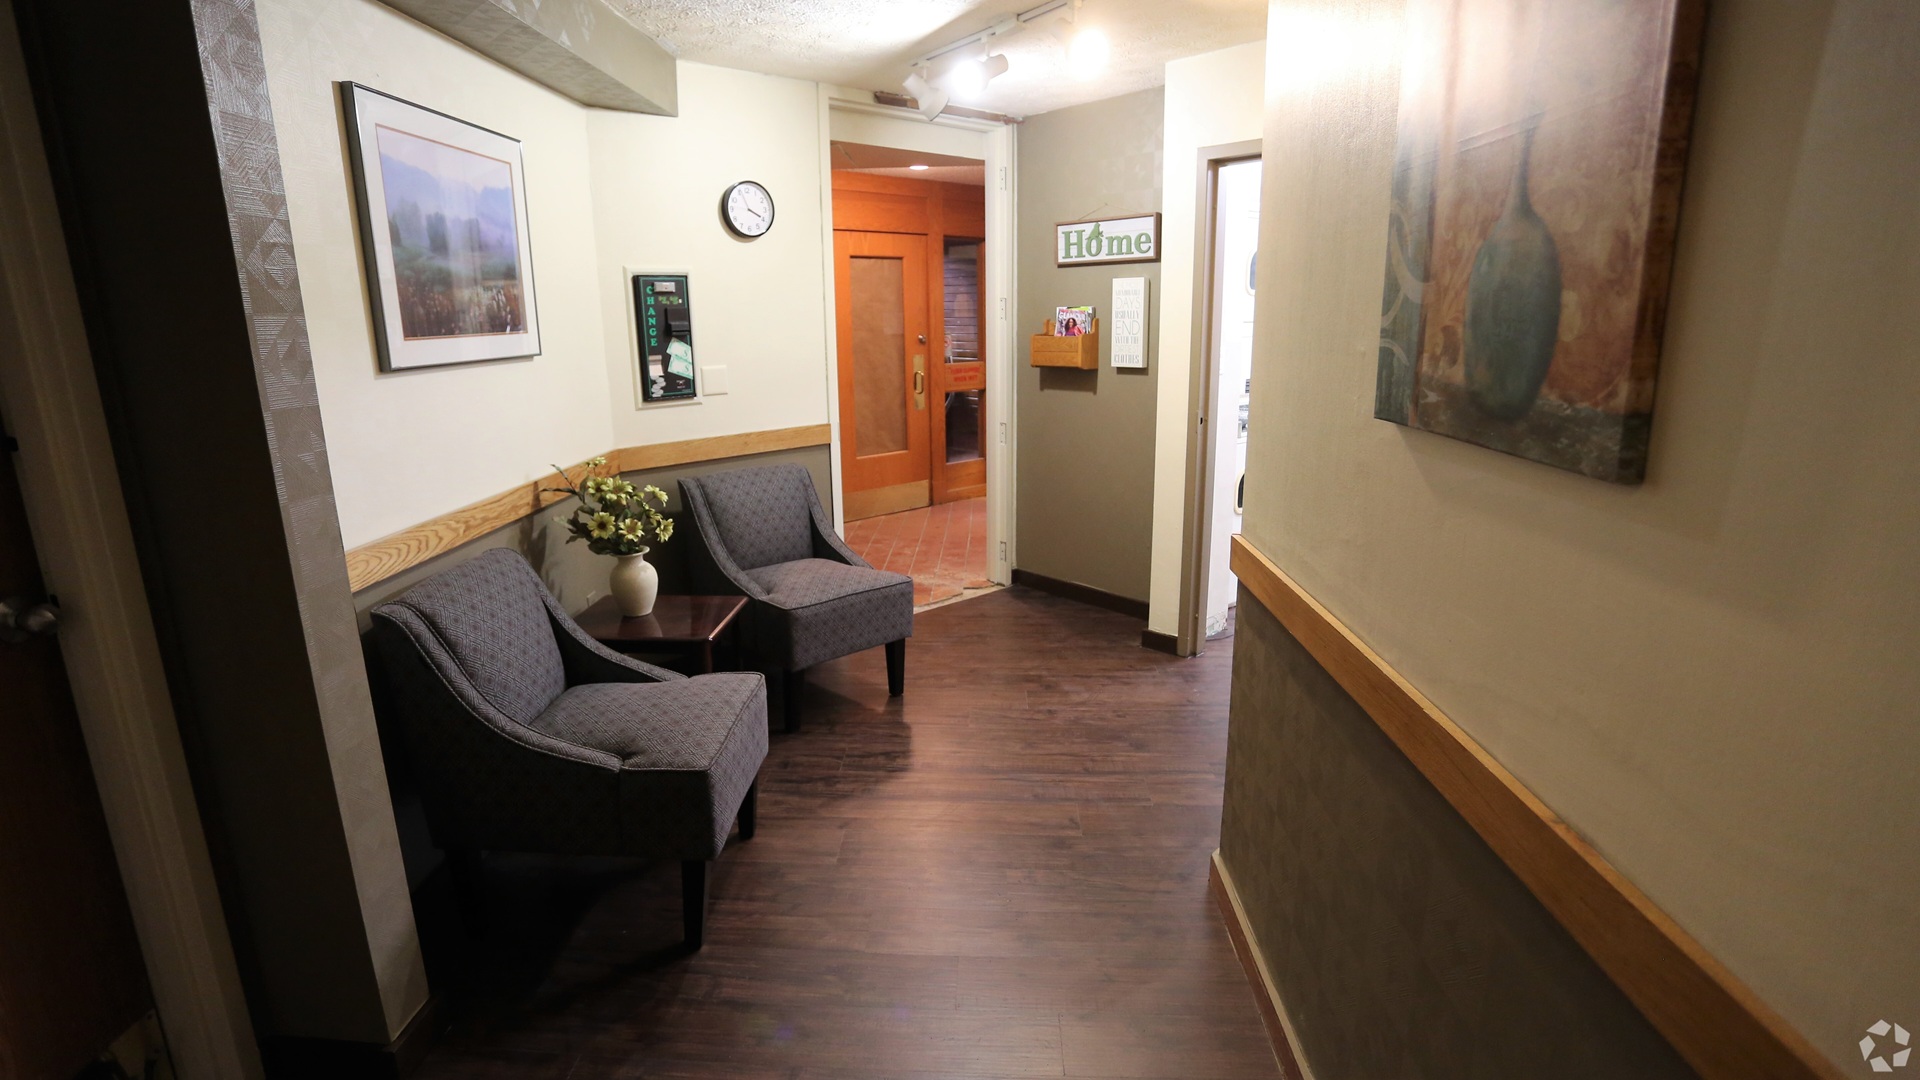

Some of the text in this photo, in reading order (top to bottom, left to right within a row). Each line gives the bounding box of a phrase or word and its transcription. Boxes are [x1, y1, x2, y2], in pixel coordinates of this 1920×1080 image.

[1061, 229, 1151, 259] Home
[1115, 296, 1141, 310] DAYS
[645, 285, 658, 346] CHANGE
[1114, 310, 1140, 320] USUALLY
[1115, 320, 1141, 335] END
[1113, 354, 1140, 364] CLOTHES
